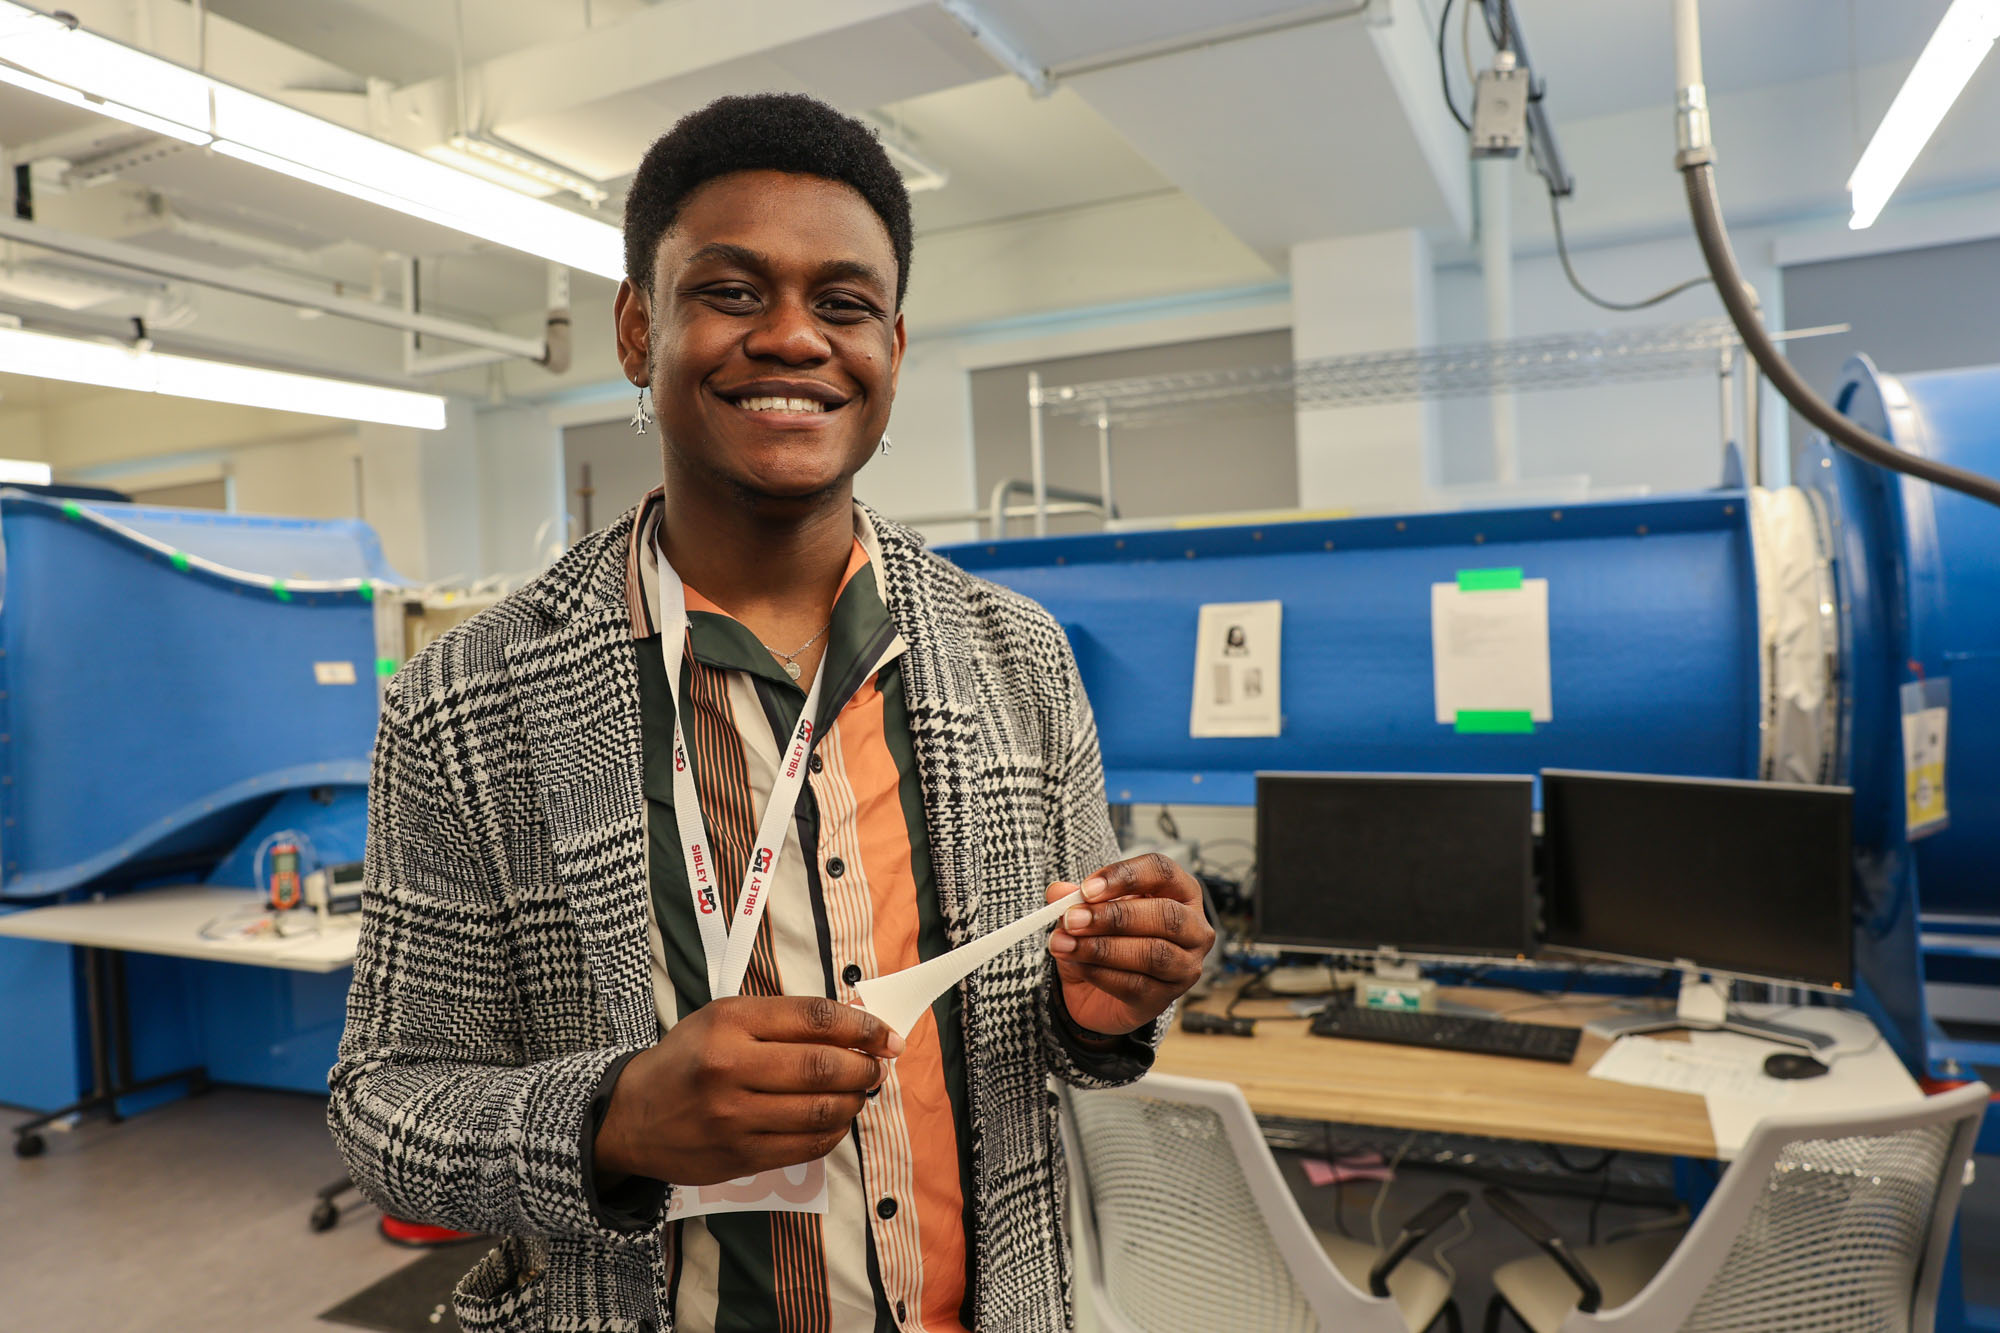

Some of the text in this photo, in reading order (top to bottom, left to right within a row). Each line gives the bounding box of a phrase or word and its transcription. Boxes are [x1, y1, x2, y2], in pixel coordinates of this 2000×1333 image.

[786, 718, 814, 779] SIBLEY 150
[691, 844, 717, 914] SIBLEY 150
[743, 847, 773, 916] SIBLEY 150
